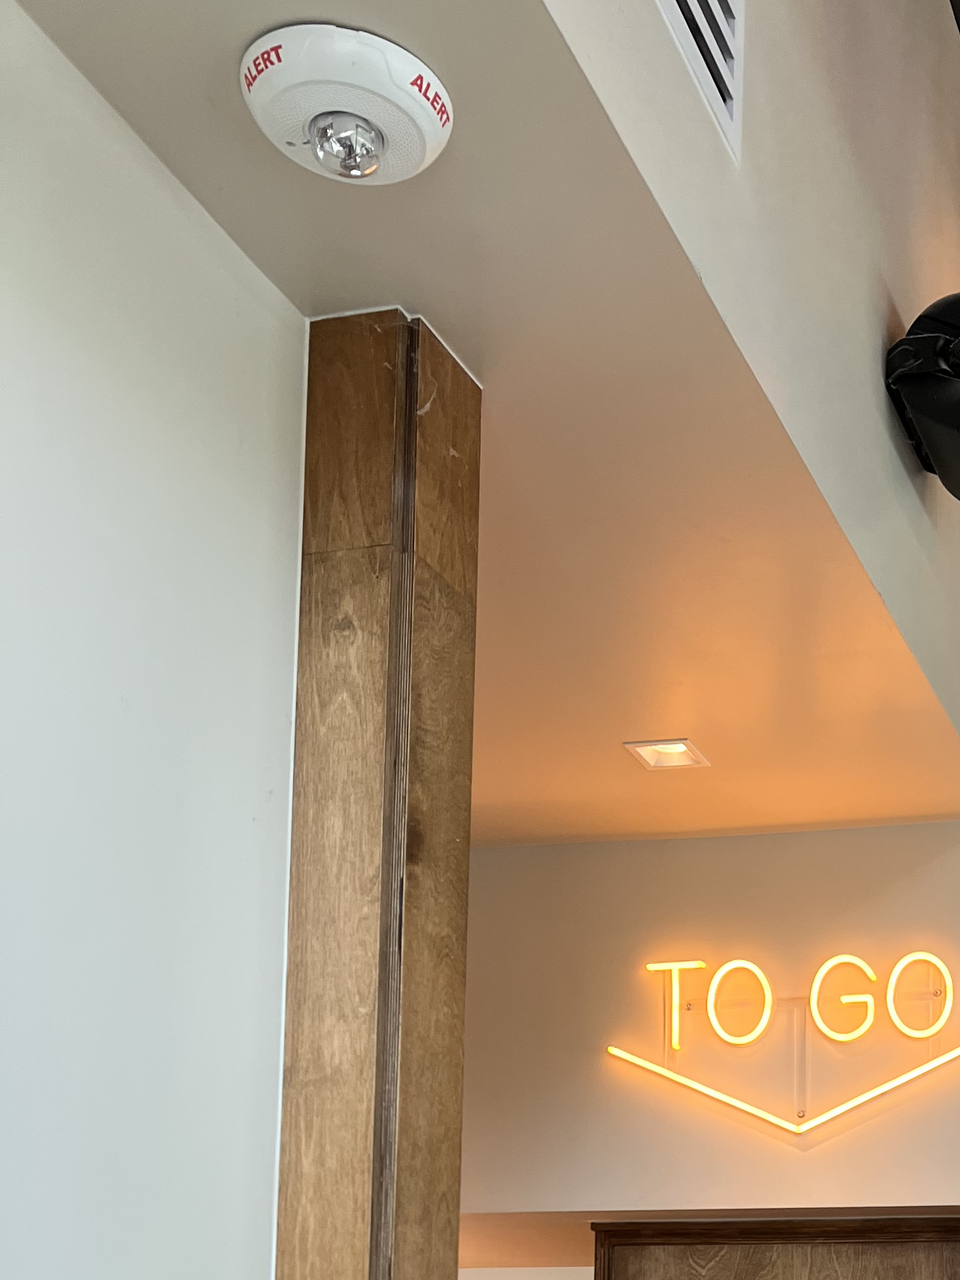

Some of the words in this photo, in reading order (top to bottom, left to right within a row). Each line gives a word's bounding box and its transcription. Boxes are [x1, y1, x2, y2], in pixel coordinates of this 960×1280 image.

[243, 44, 283, 93] ALERT
[410, 74, 451, 128] ALERT
[645, 959, 772, 1050] TO
[810, 951, 954, 1042] GO
